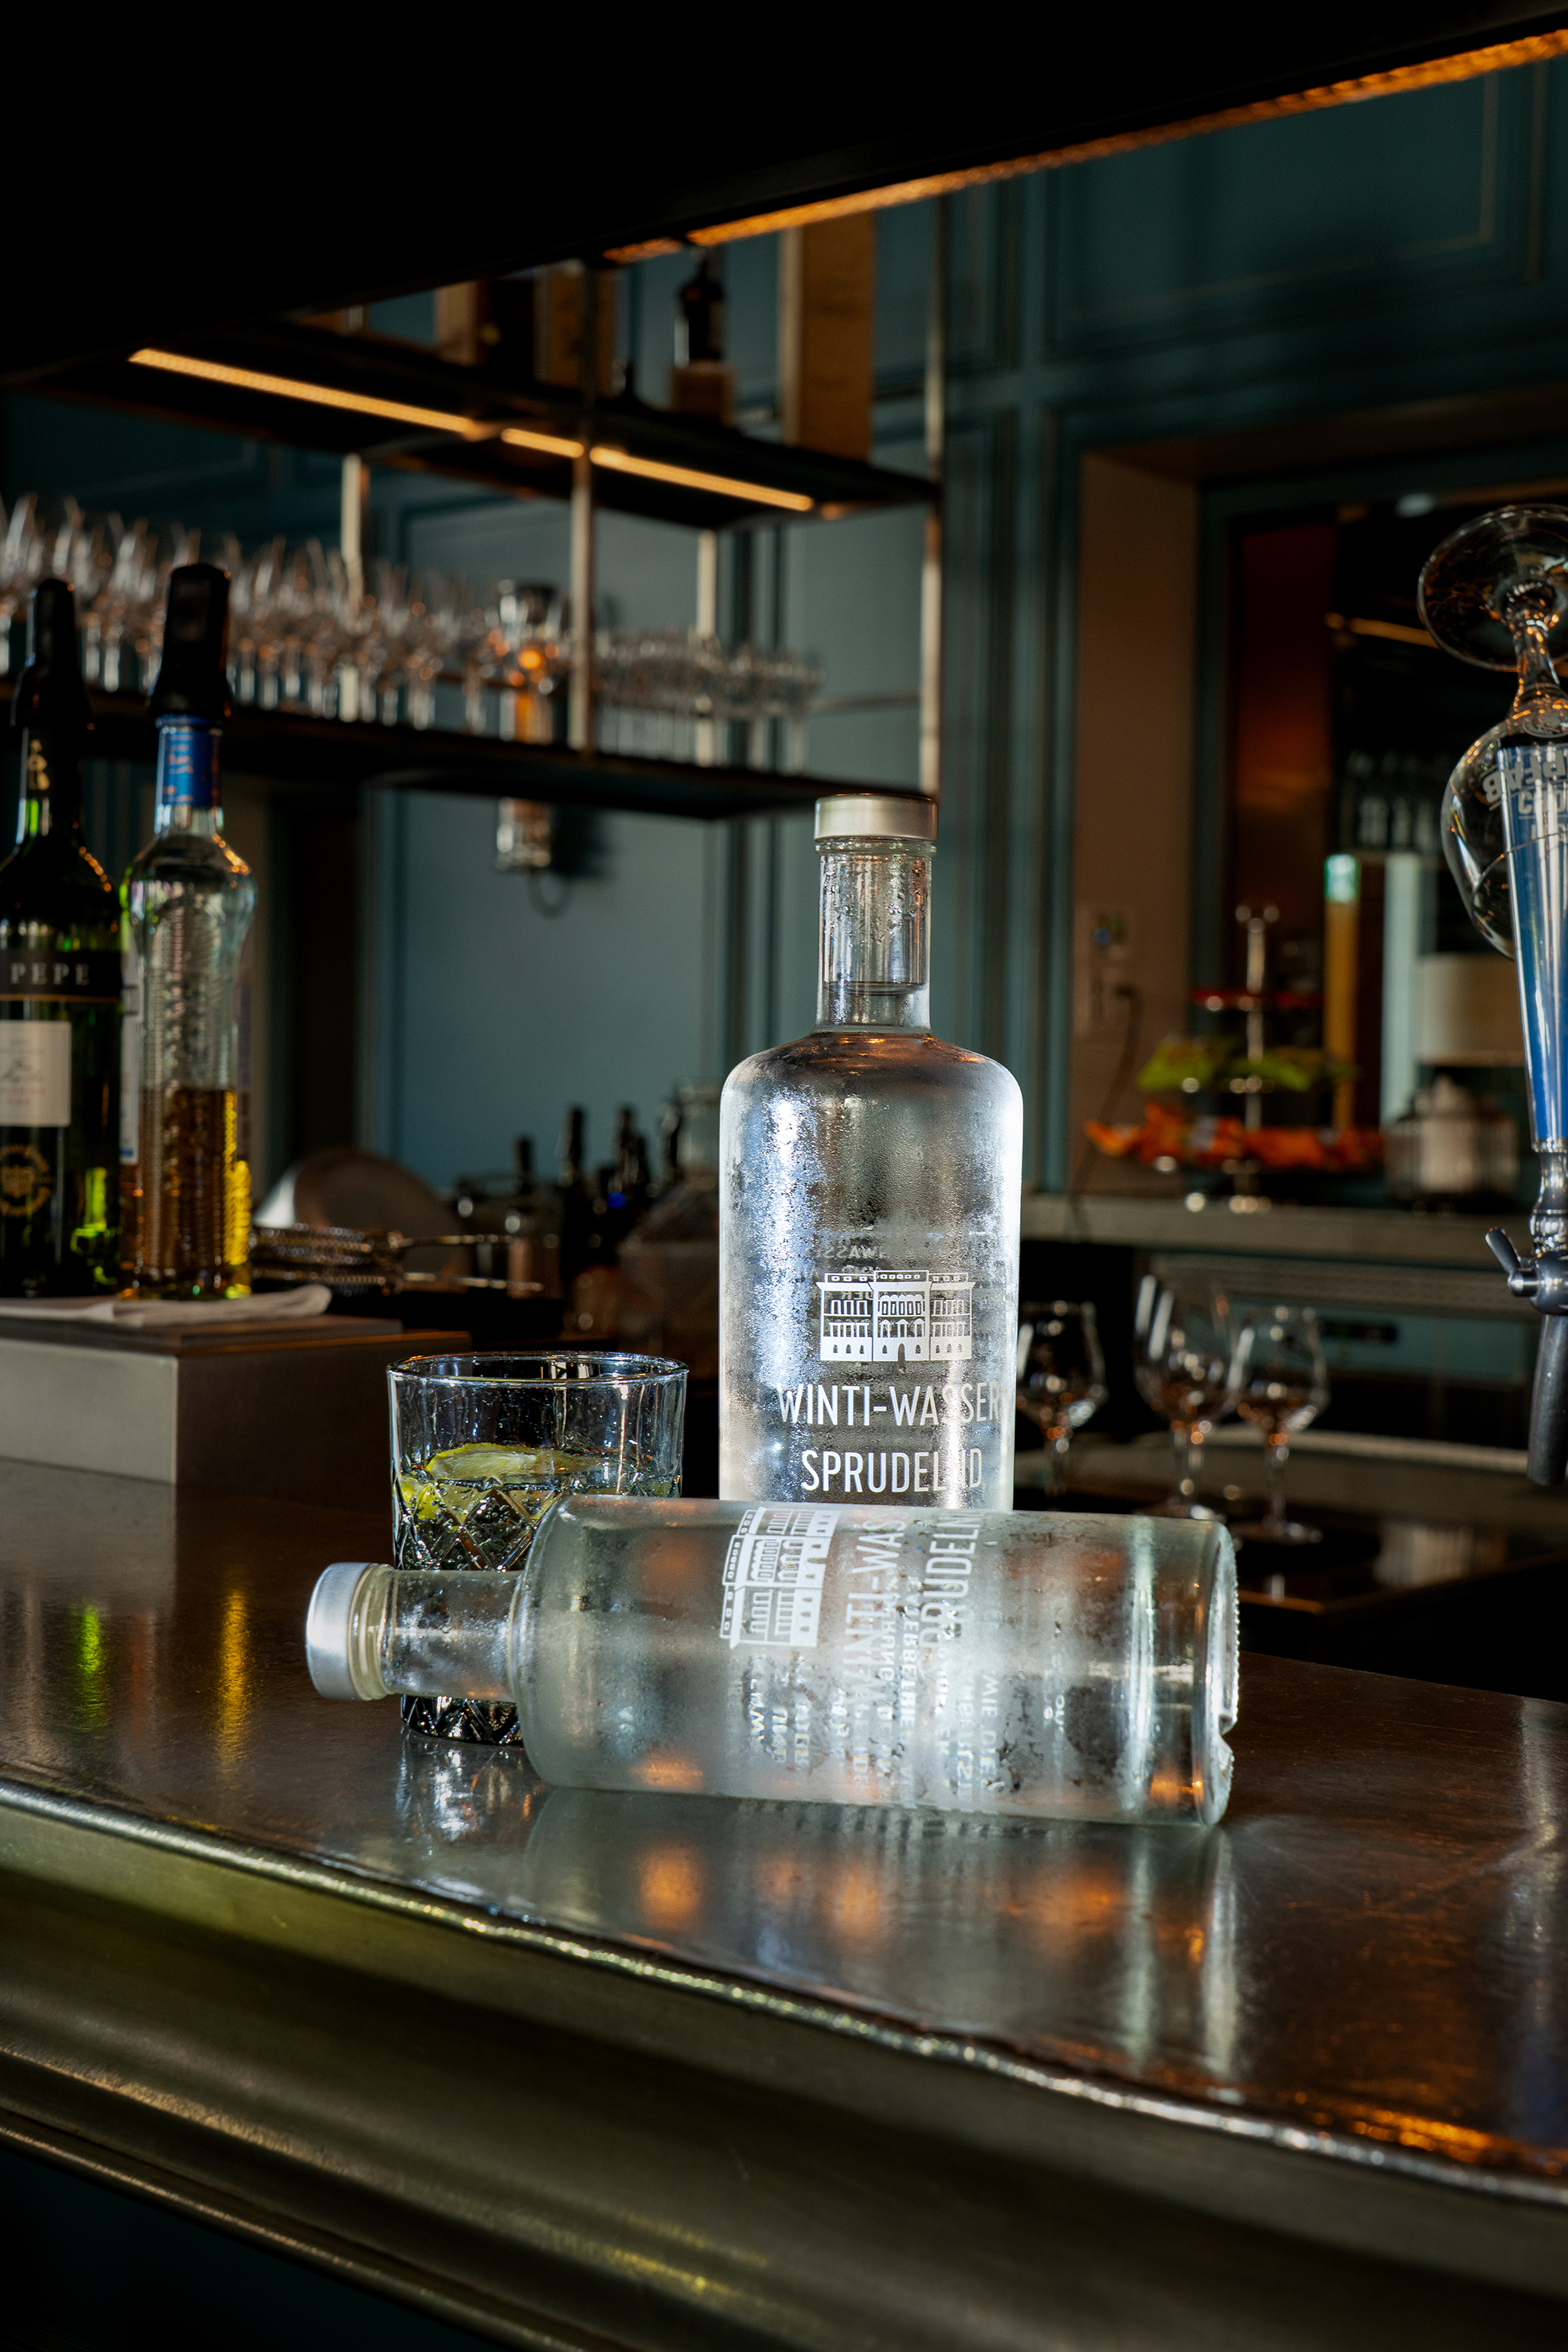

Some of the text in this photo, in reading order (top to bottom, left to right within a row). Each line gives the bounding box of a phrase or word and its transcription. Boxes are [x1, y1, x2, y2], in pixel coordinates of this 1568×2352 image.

[10, 962, 90, 985] PEPE
[776, 1380, 1000, 1426] WINTI-WASSER
[917, 1513, 983, 1679] SPRUDELN
